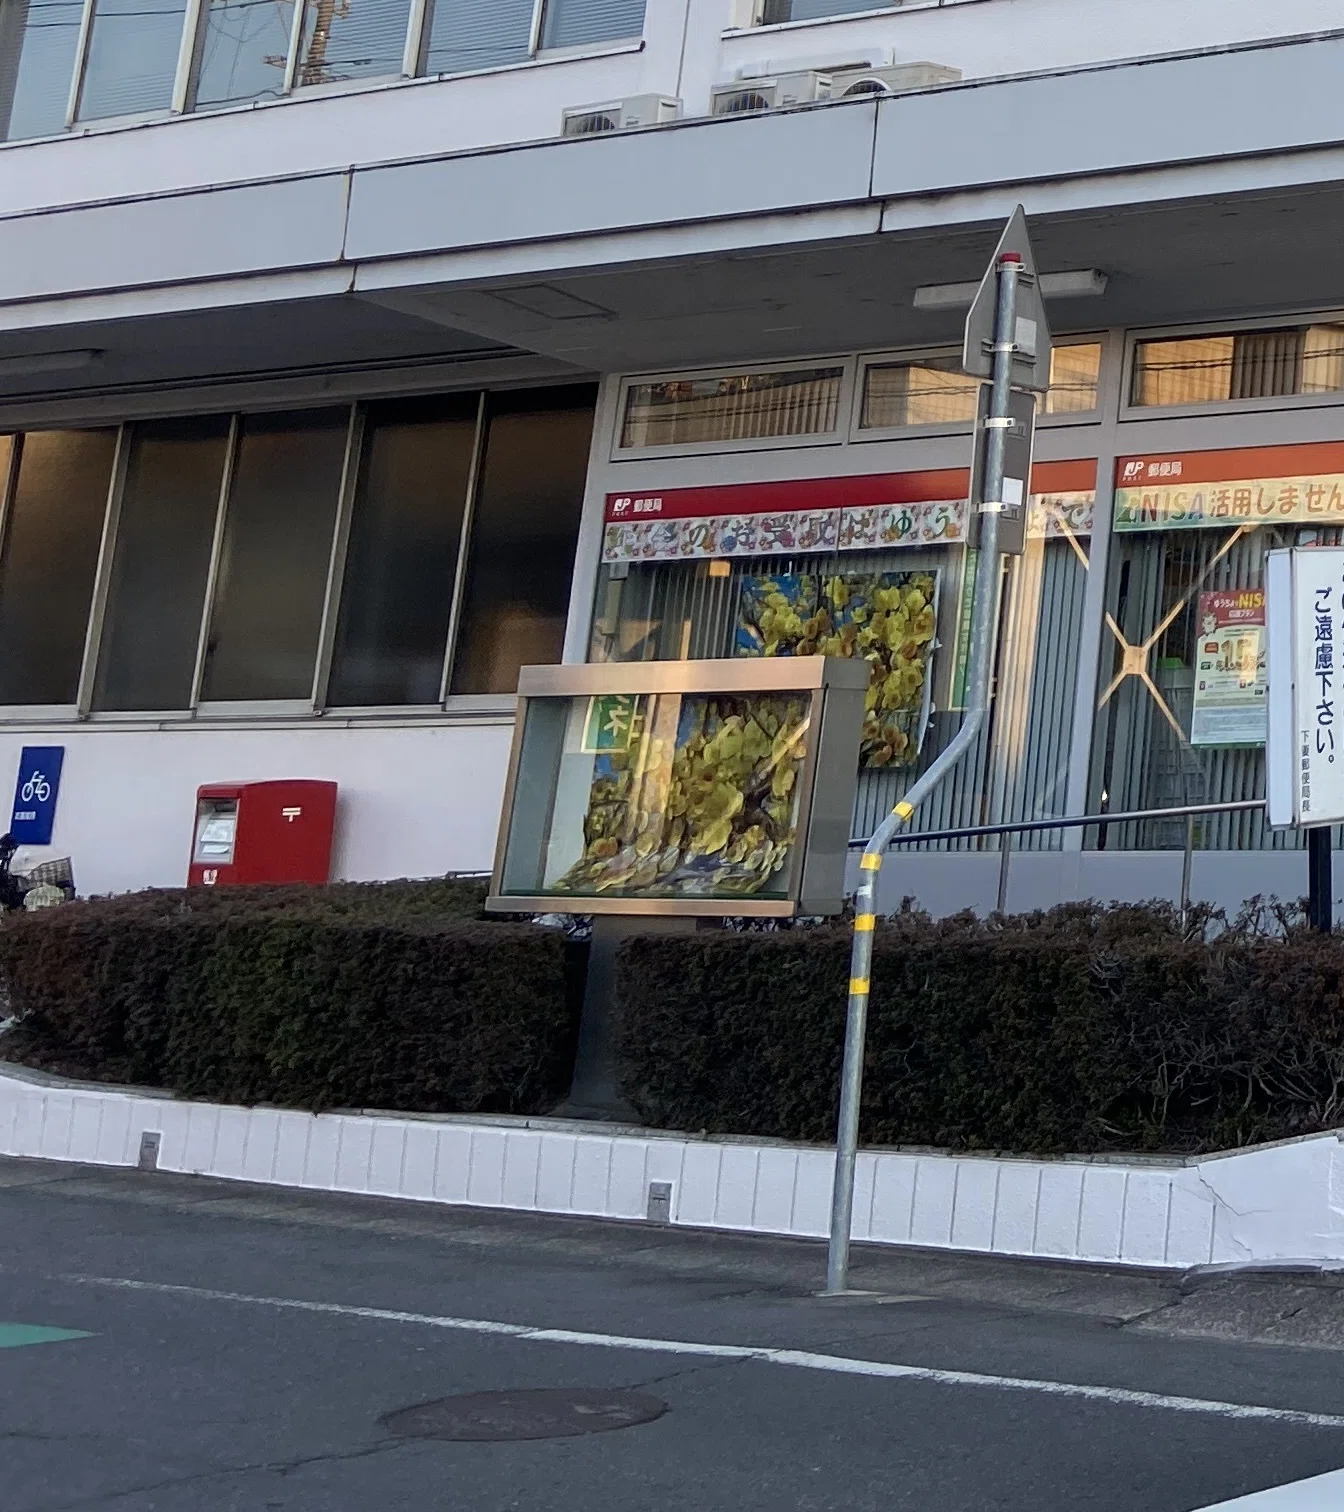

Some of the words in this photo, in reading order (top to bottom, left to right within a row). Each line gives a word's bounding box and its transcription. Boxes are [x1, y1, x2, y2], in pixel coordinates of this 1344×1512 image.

[1148, 461, 1182, 477] 郵便局
[633, 498, 663, 514] 郵便局
[1314, 586, 1335, 764] ご遠慮下さい。
[1300, 729, 1312, 813] 下妻郵便局長
